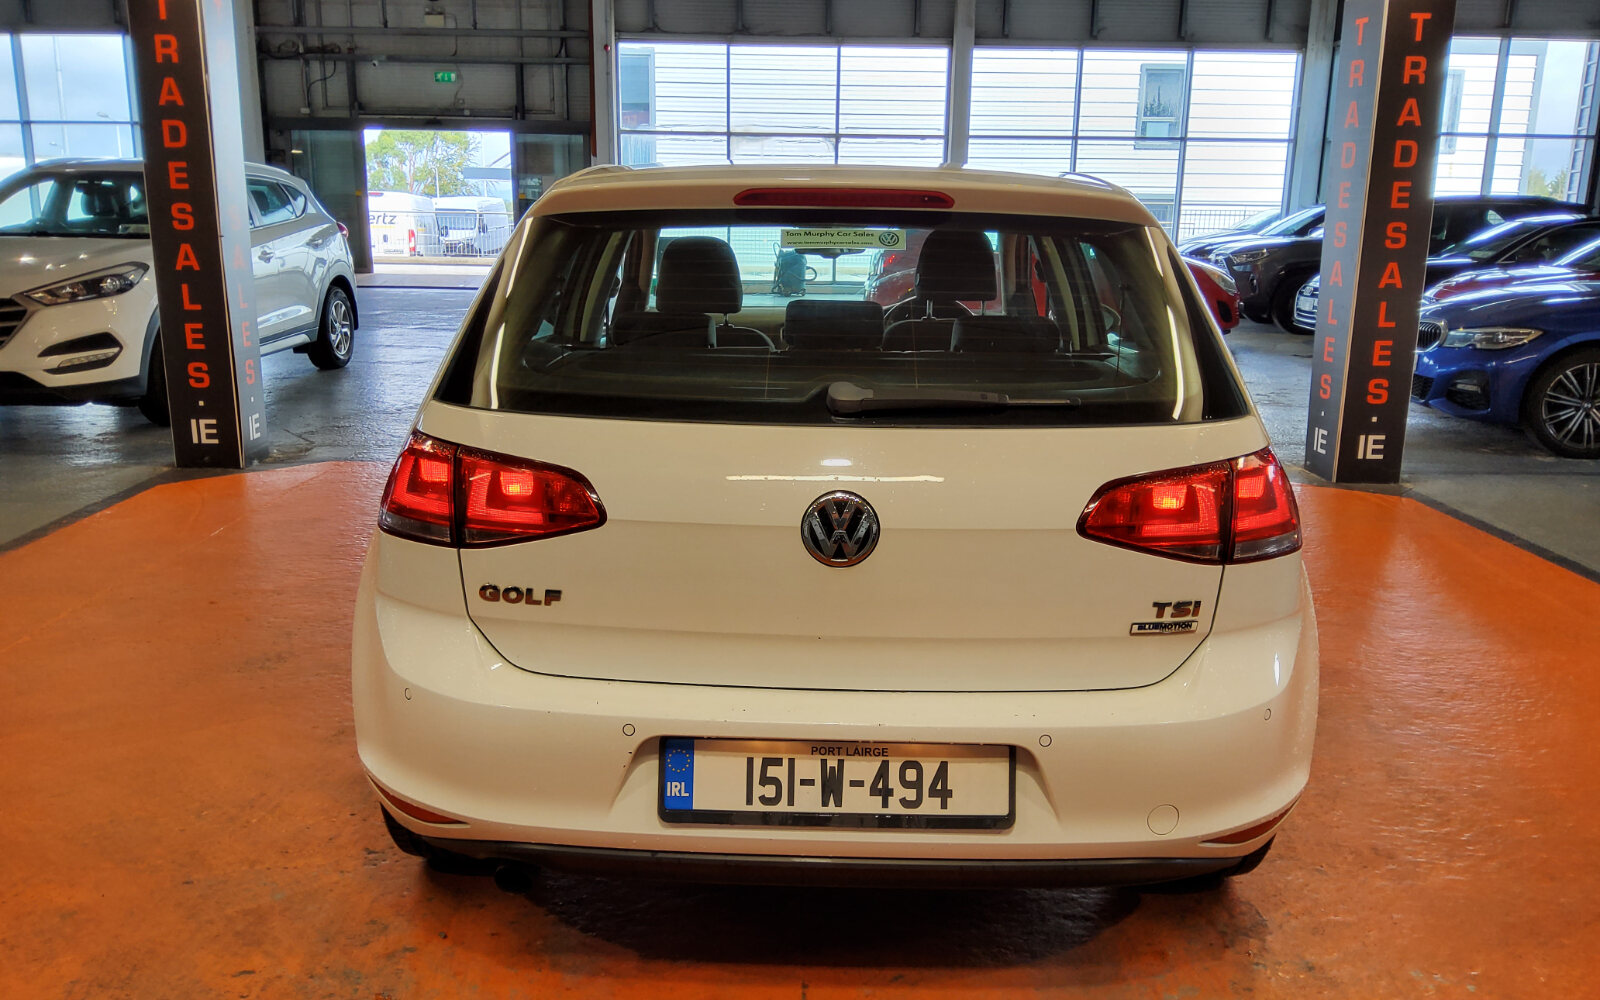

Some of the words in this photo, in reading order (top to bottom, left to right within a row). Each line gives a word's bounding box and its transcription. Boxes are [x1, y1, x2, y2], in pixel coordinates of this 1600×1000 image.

[369, 213, 397, 225] ertz
[479, 583, 562, 606] GOLF
[1152, 600, 1202, 619] TSI
[1137, 622, 1193, 631] BLUEMOTION
[811, 746, 843, 756] PORT
[666, 781, 690, 797] IRL
[745, 756, 953, 810] 151-W-494
